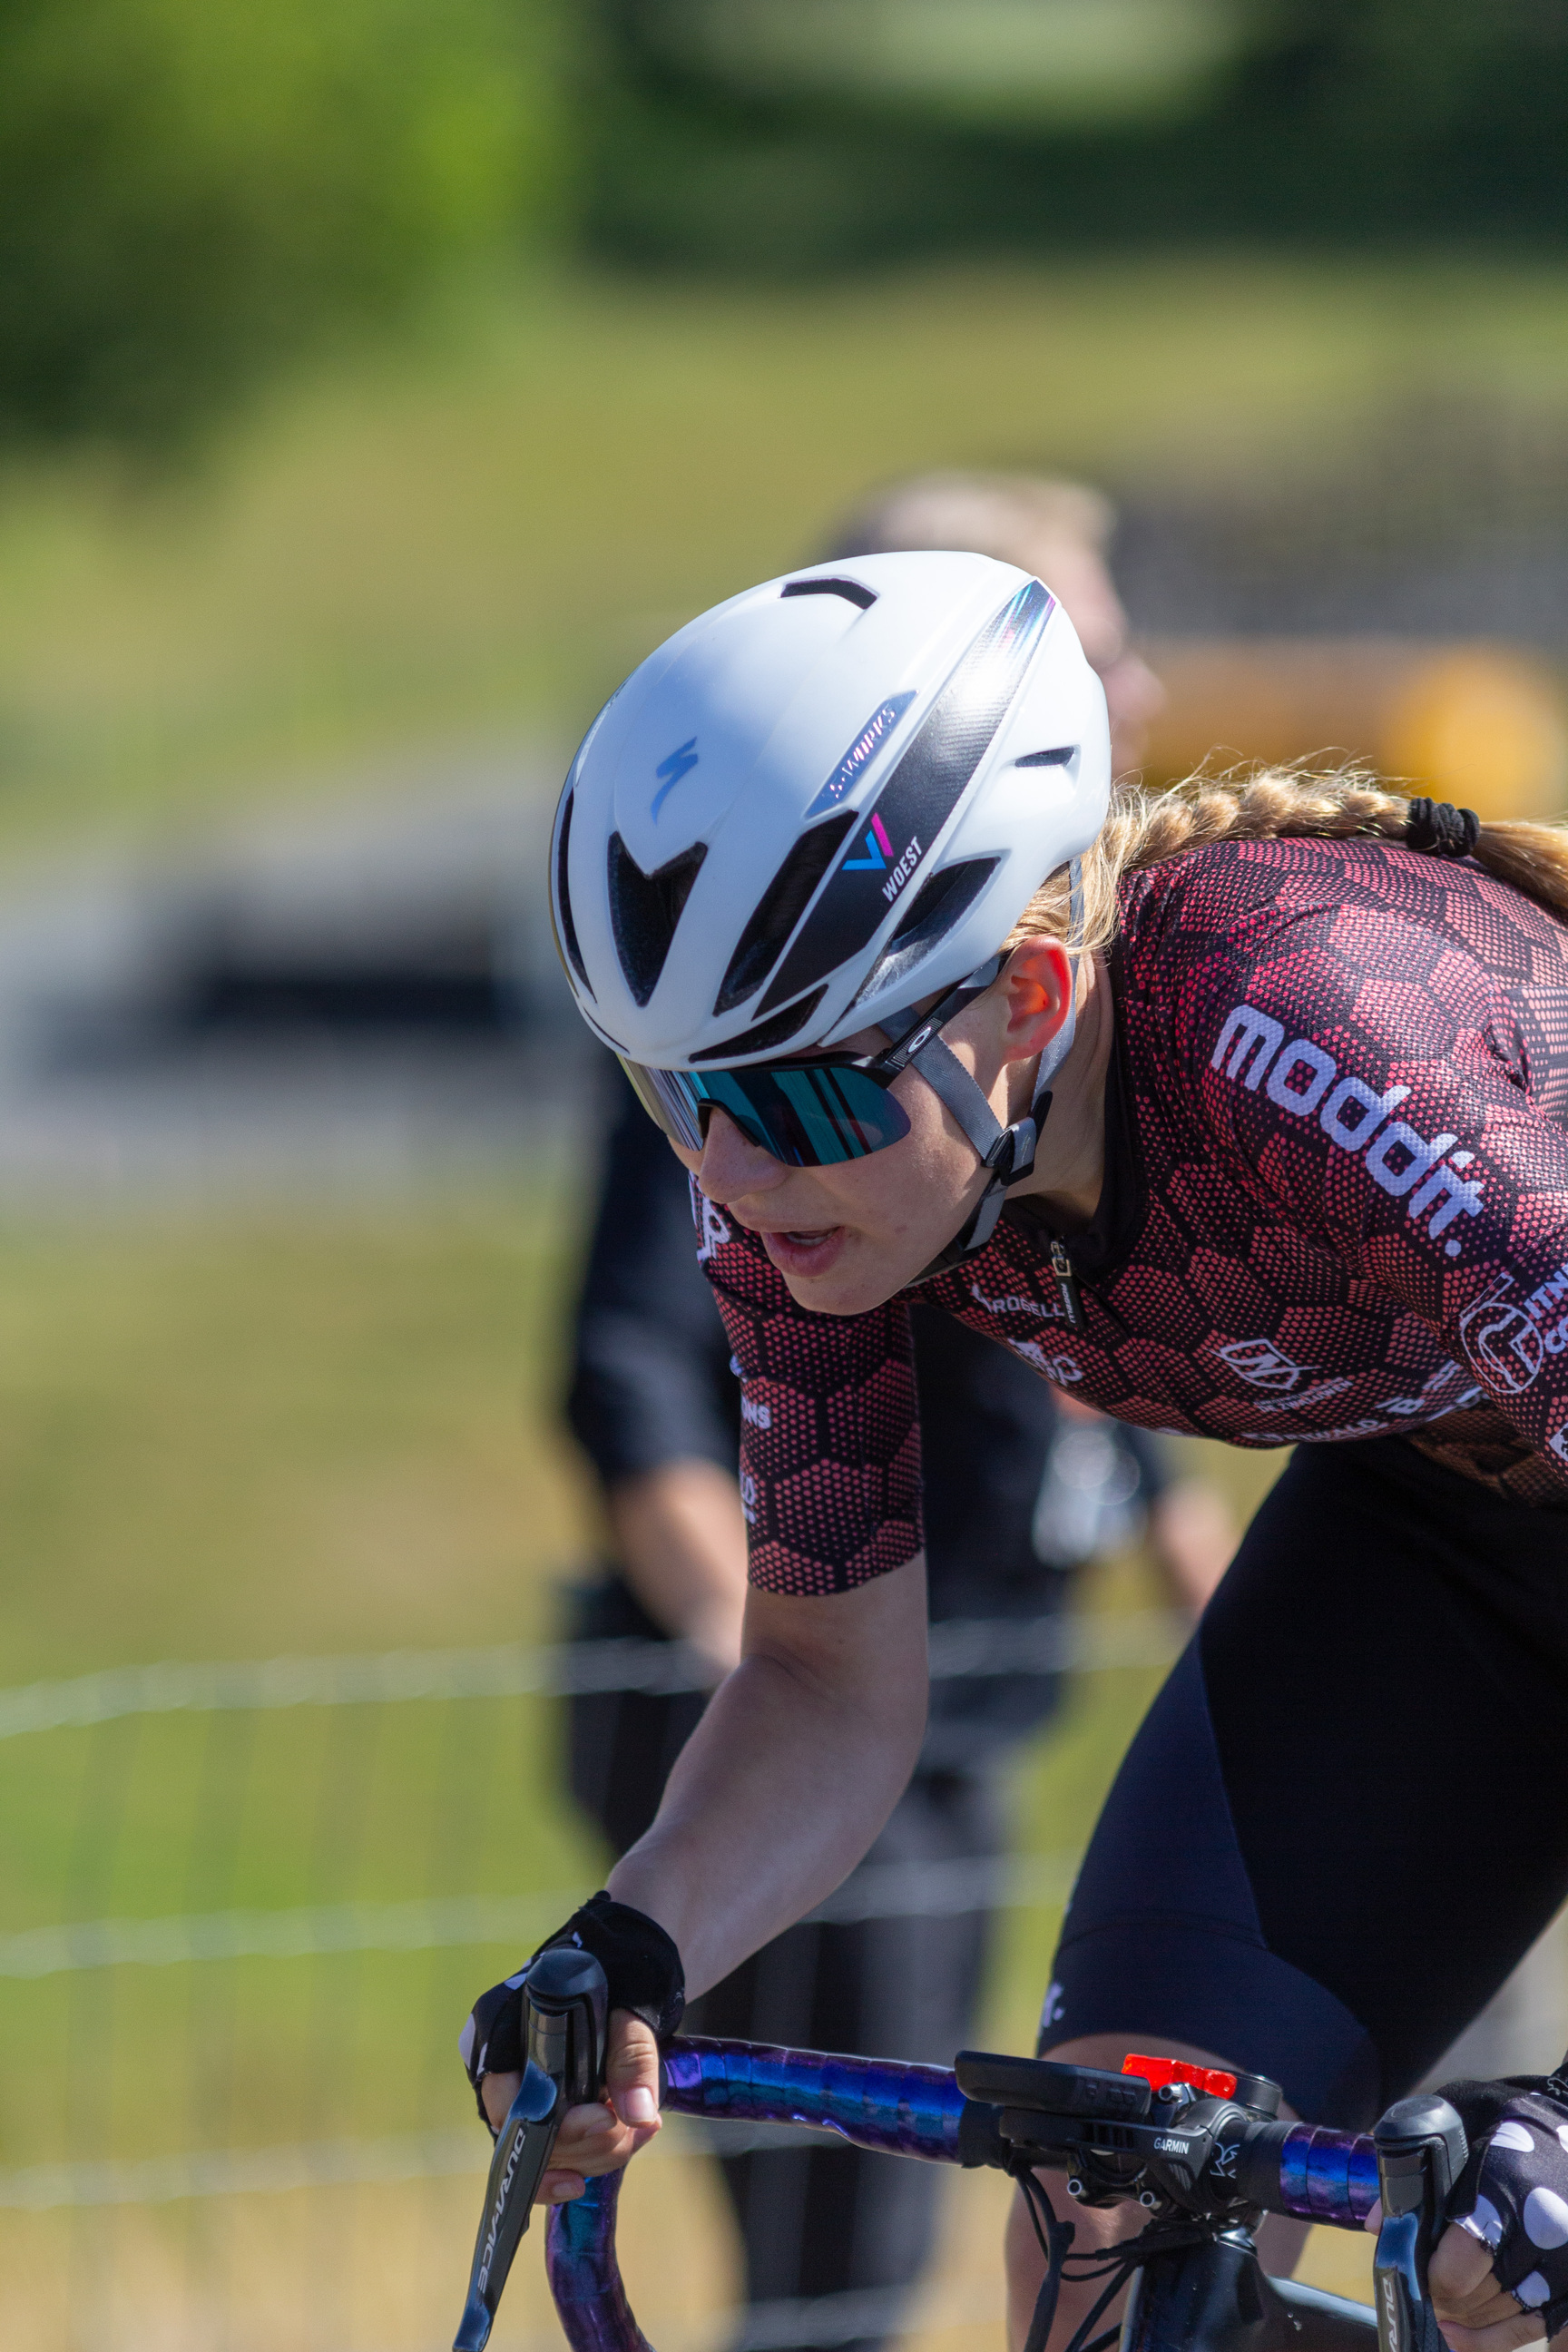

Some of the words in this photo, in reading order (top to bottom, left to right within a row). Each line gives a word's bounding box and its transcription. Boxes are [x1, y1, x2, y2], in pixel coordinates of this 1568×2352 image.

[881, 836, 923, 903] WOEST
[992, 1295, 1065, 1318] ROGELL
[1524, 1262, 1568, 1320] ITN
[1153, 2137, 1190, 2155] GARMIN
